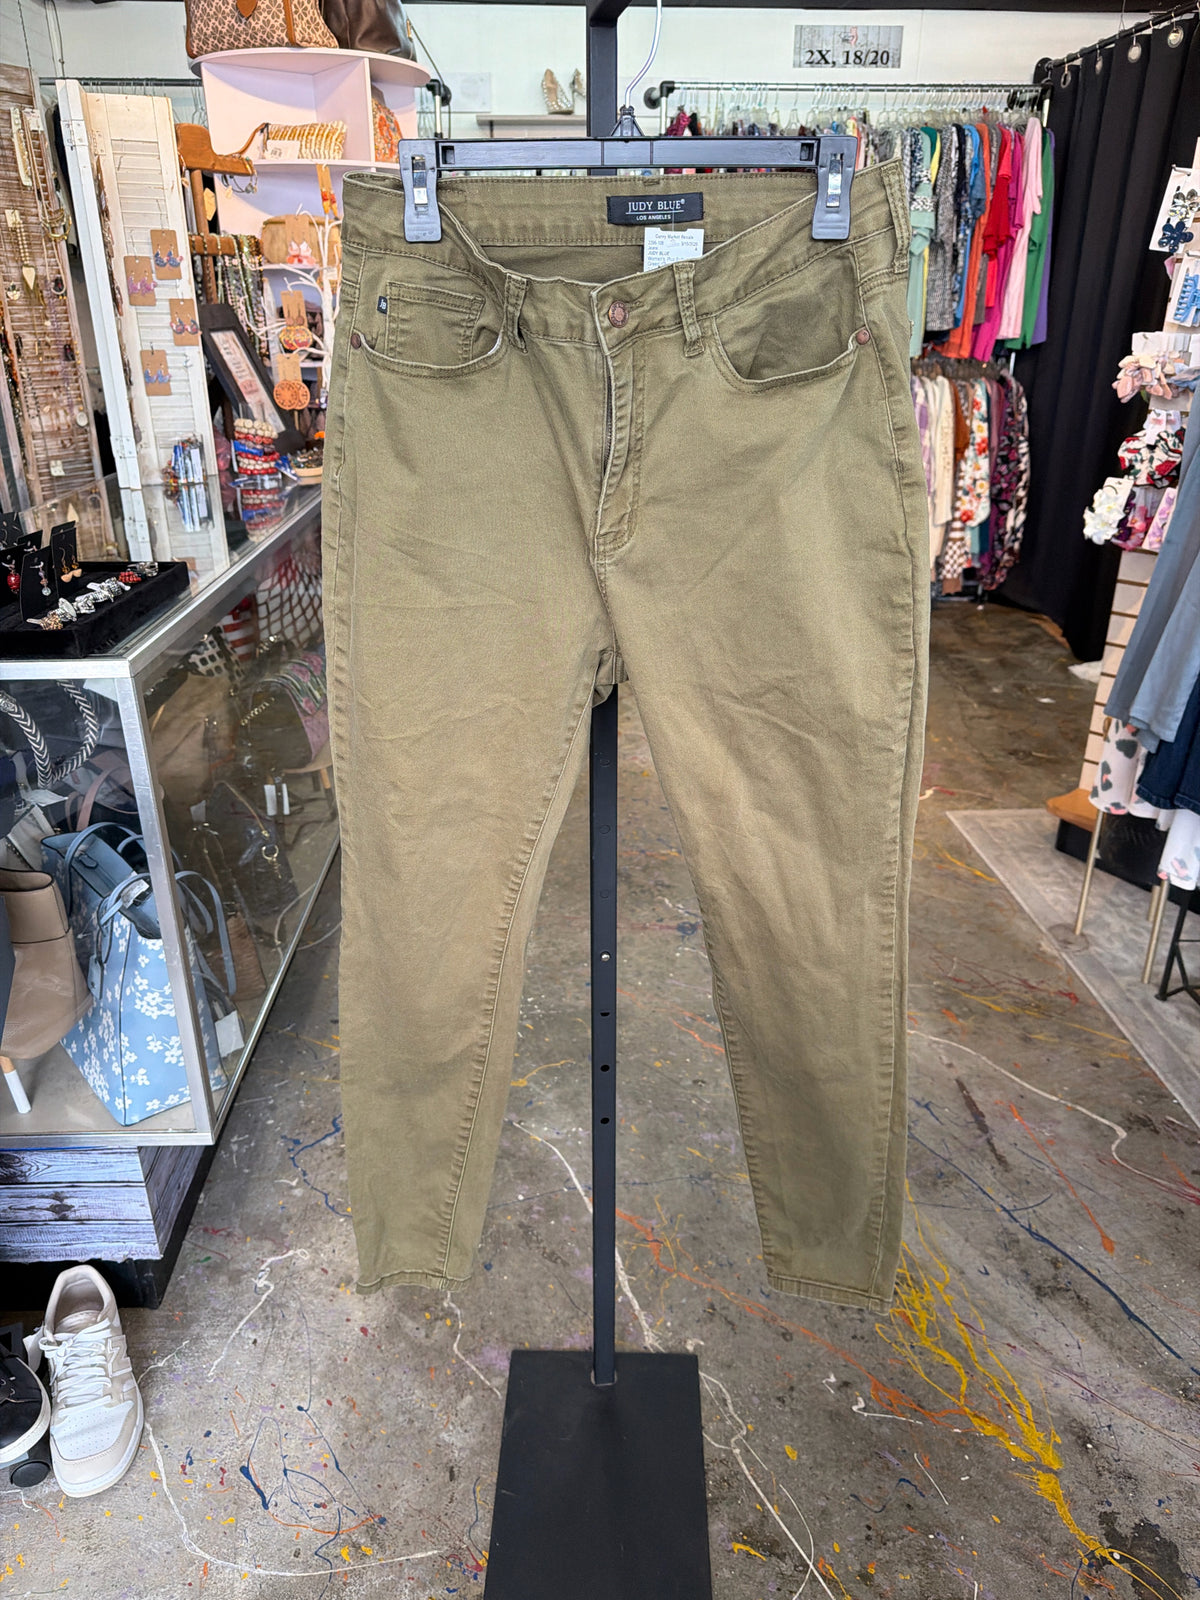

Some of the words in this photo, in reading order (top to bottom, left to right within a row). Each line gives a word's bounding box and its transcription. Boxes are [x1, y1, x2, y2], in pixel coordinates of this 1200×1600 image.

[805, 49, 836, 67] 2X,
[842, 48, 890, 67] 18/20
[627, 201, 654, 213] JUDY
